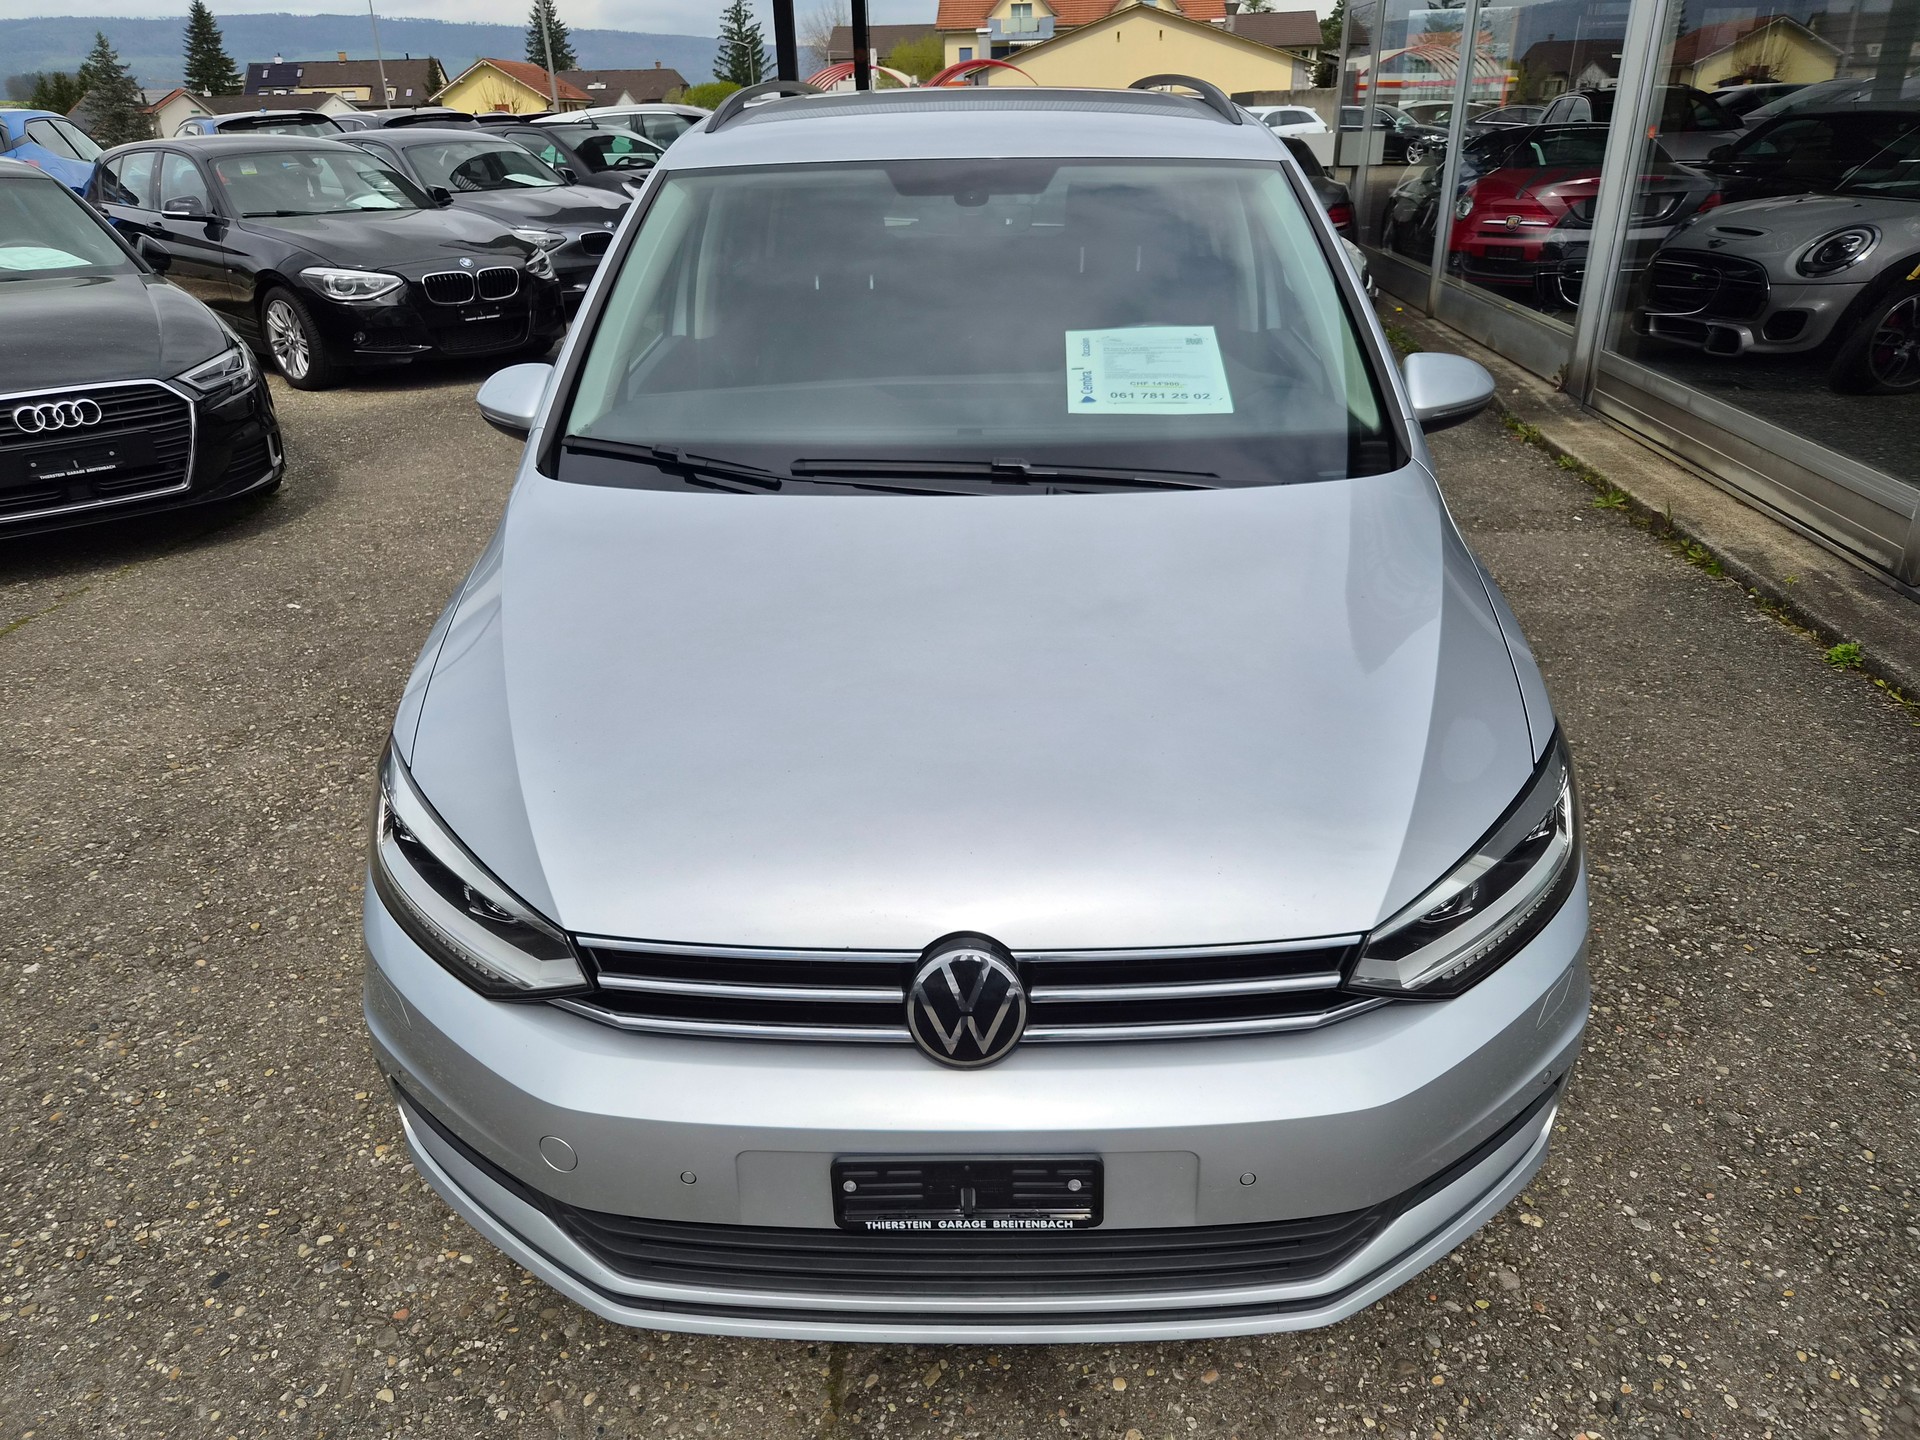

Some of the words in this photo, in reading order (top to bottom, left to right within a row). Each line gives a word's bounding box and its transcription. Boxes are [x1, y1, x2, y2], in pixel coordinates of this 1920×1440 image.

[1080, 371, 1093, 394] Cembra
[865, 1220, 932, 1230] THIERSTEIN
[938, 1220, 987, 1229] GARAGE
[993, 1220, 1074, 1229] BREITENBACH
